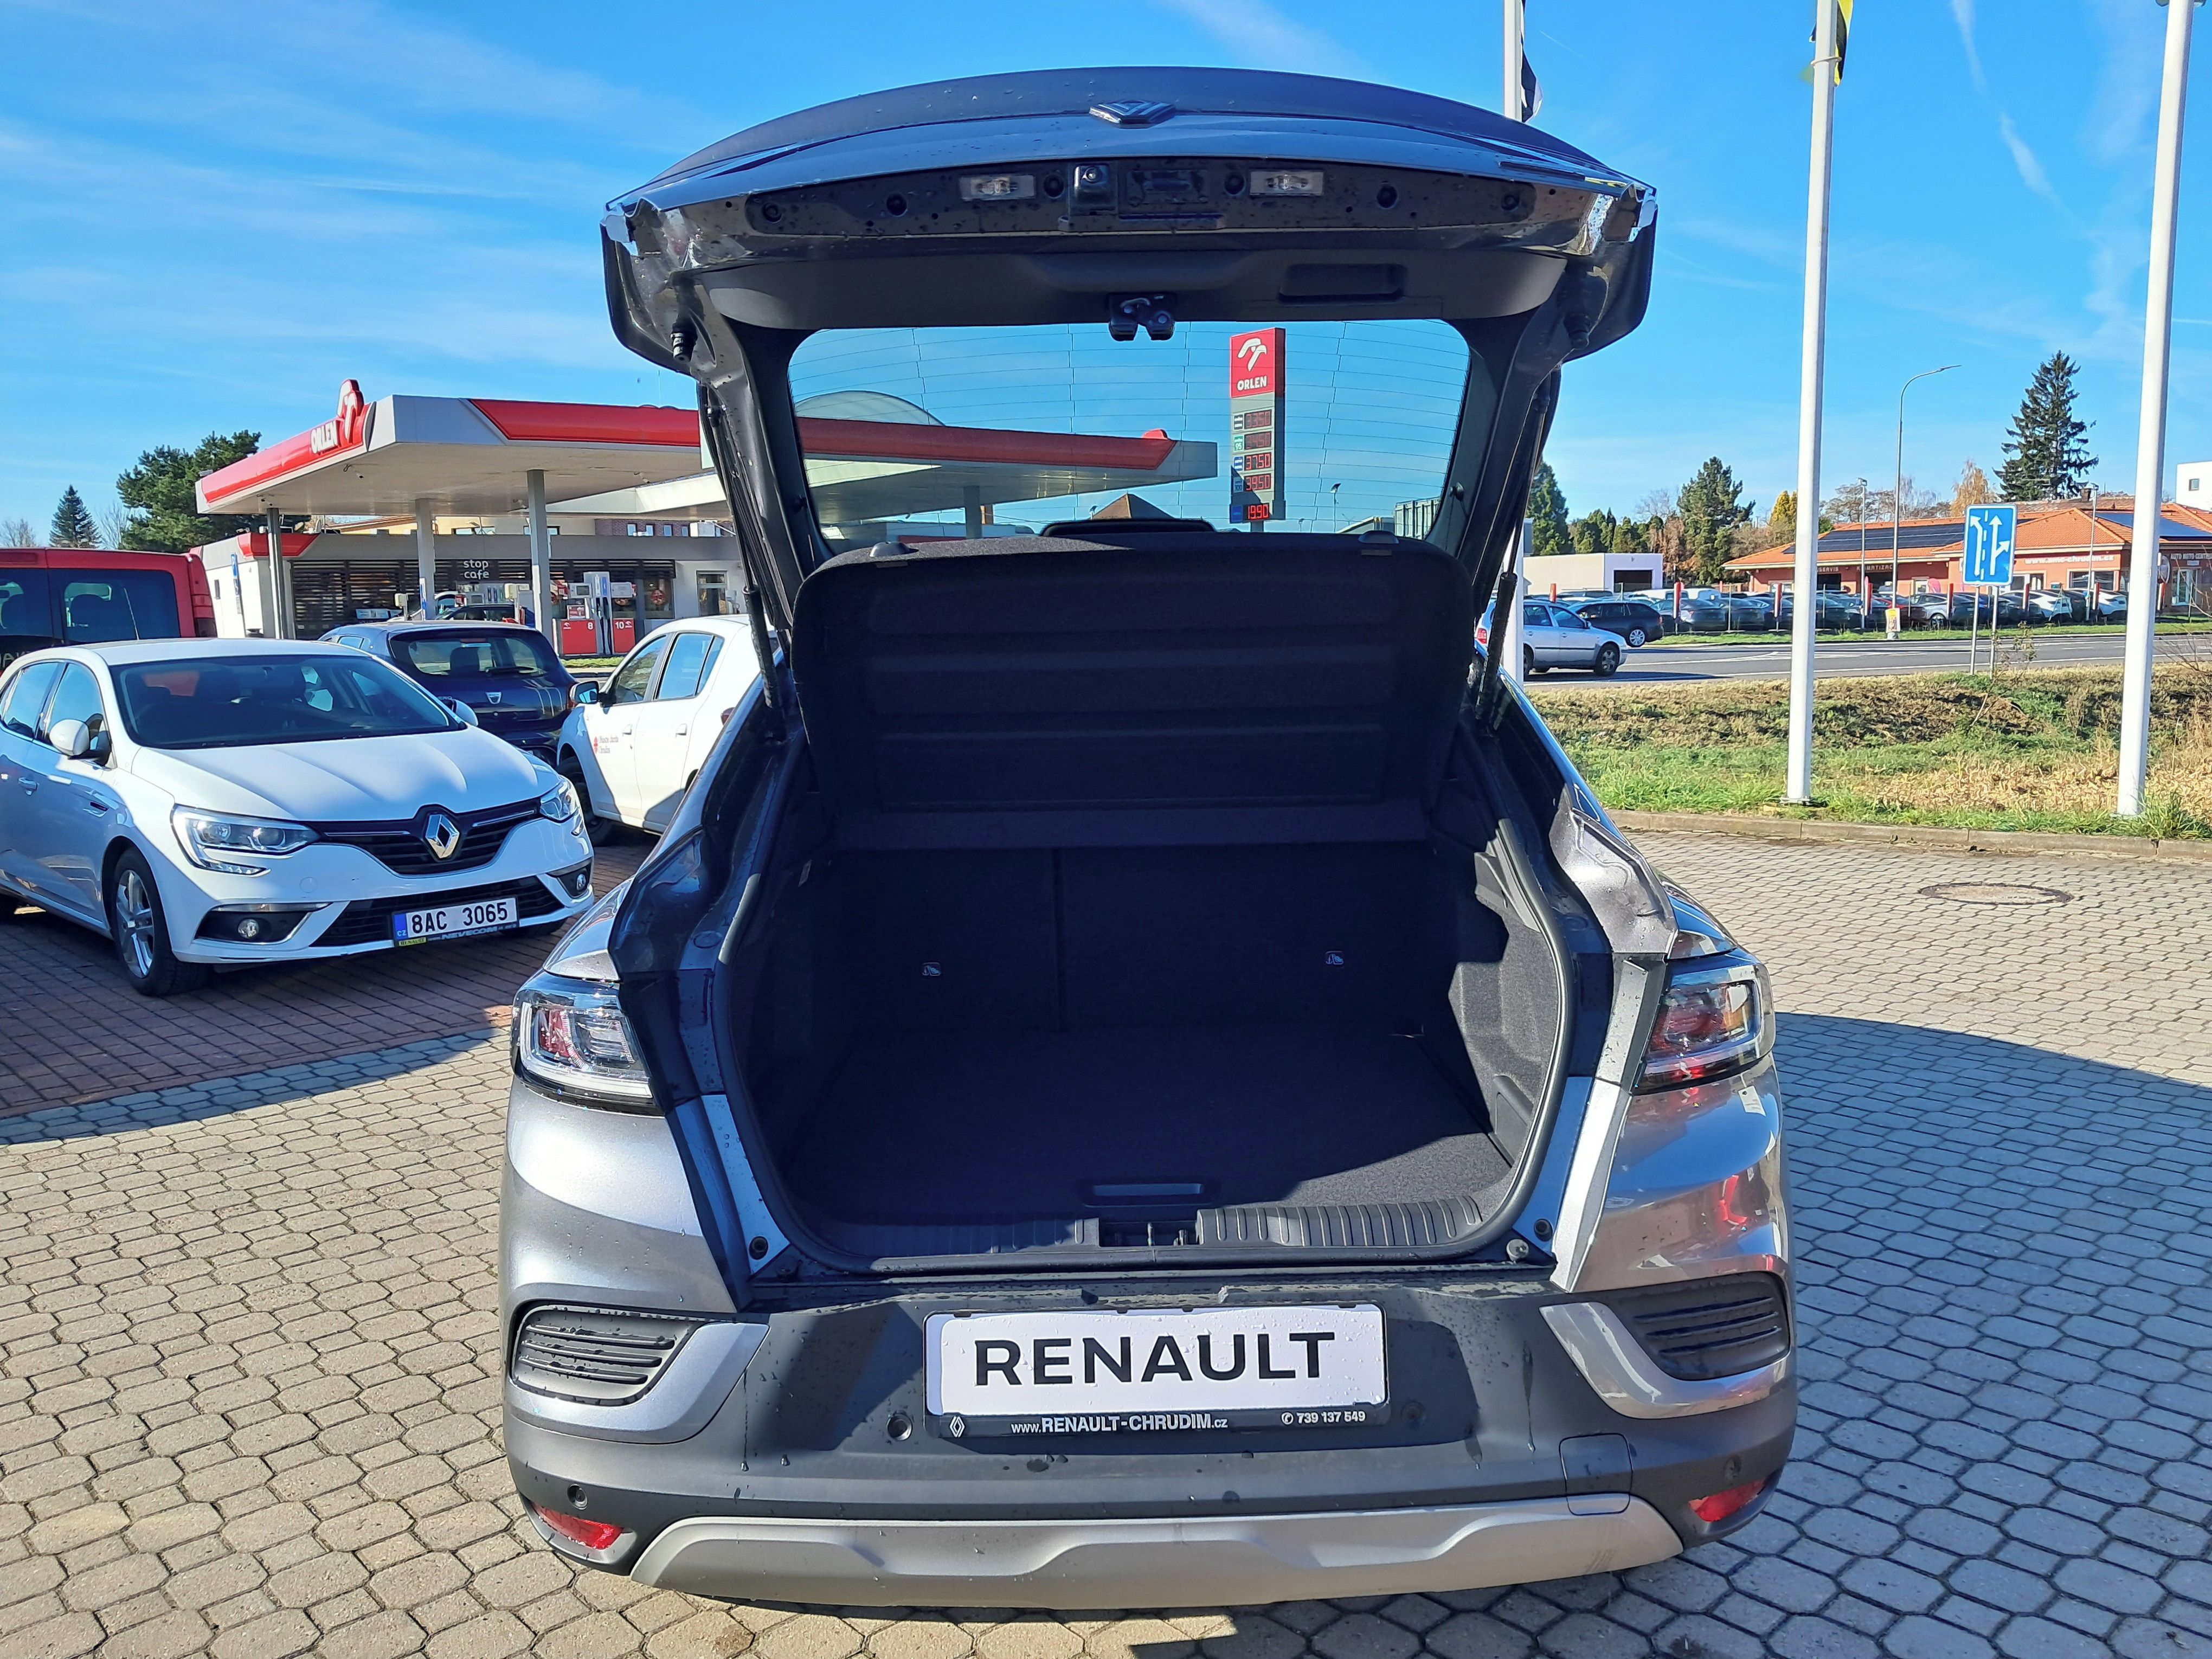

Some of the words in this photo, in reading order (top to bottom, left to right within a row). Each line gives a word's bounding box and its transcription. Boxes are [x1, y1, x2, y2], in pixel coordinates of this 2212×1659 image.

[1237, 376, 1267, 390] ORLEN
[311, 420, 338, 454] ORLEN
[464, 560, 488, 570] stop
[464, 569, 490, 580] cafe
[411, 911, 447, 934] 8AC
[462, 902, 508, 926] 3065
[975, 1332, 1335, 1386] RENAULT
[1011, 1413, 1228, 1433] www.RENAULT-CHRUDIM.cz
[1296, 1412, 1319, 1424] 739
[1321, 1411, 1342, 1423] 137
[1344, 1411, 1366, 1423] 549
